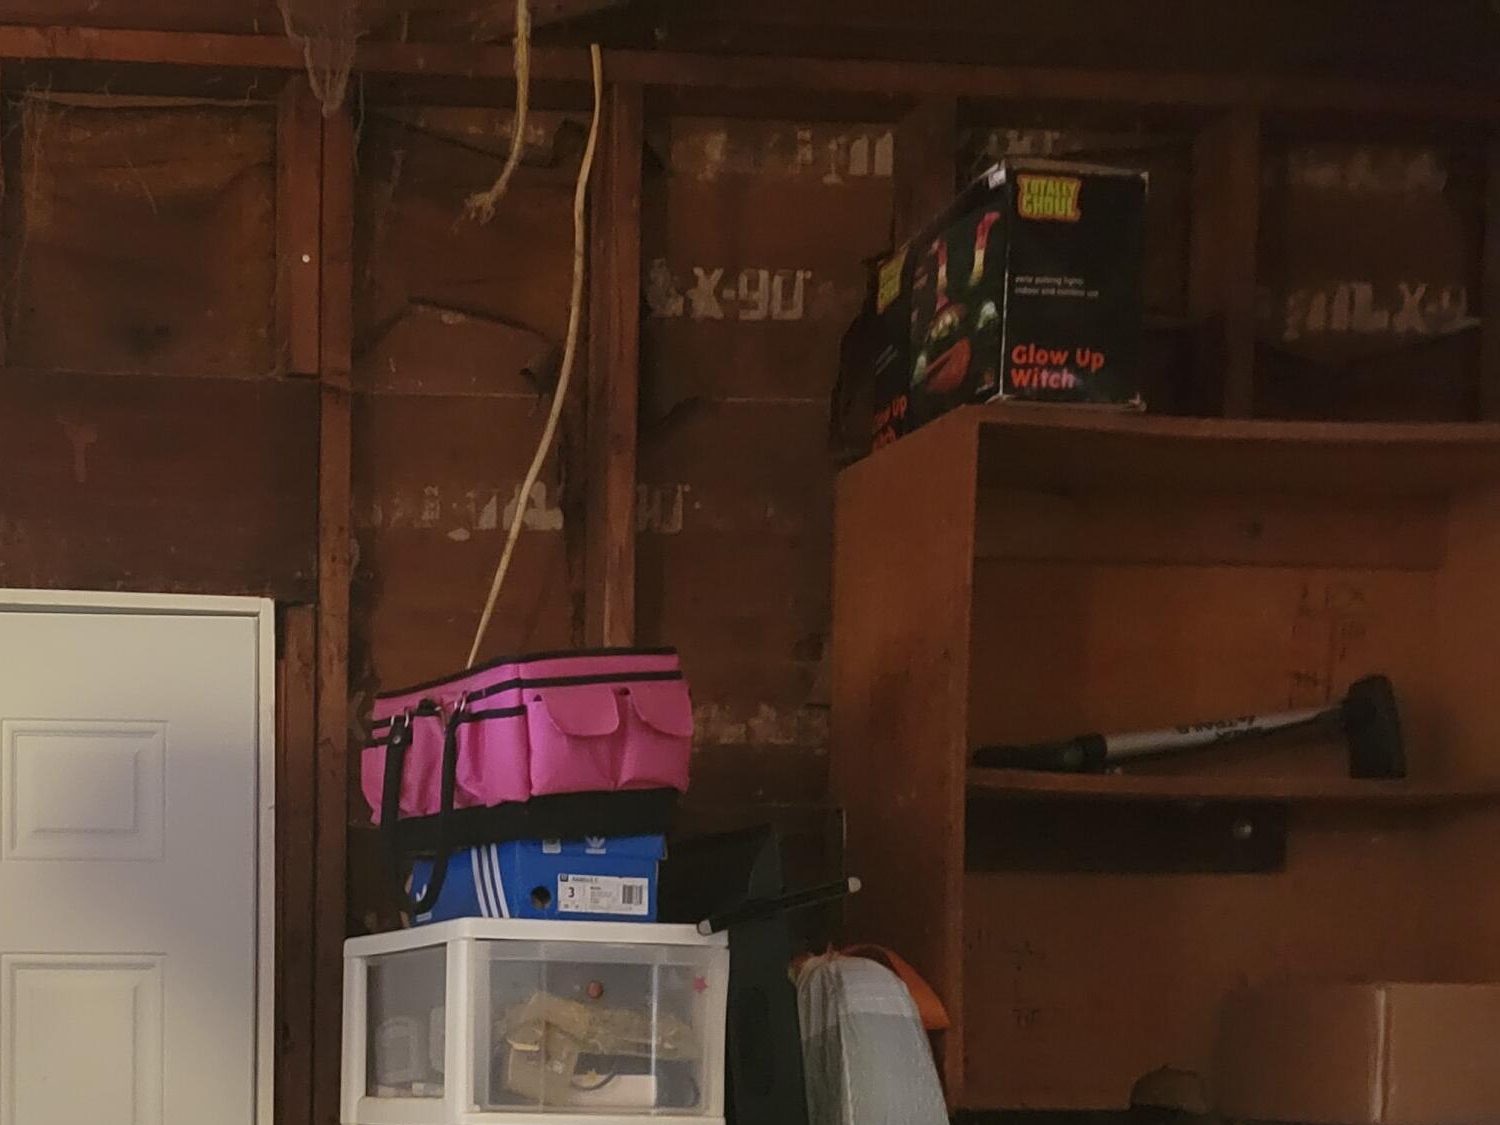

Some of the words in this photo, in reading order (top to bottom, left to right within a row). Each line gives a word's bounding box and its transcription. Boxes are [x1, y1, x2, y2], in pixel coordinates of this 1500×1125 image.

[1011, 343, 1069, 366] Glow
[1075, 347, 1105, 373] Up
[1011, 367, 1077, 389] Witch
[567, 886, 575, 898] 3
